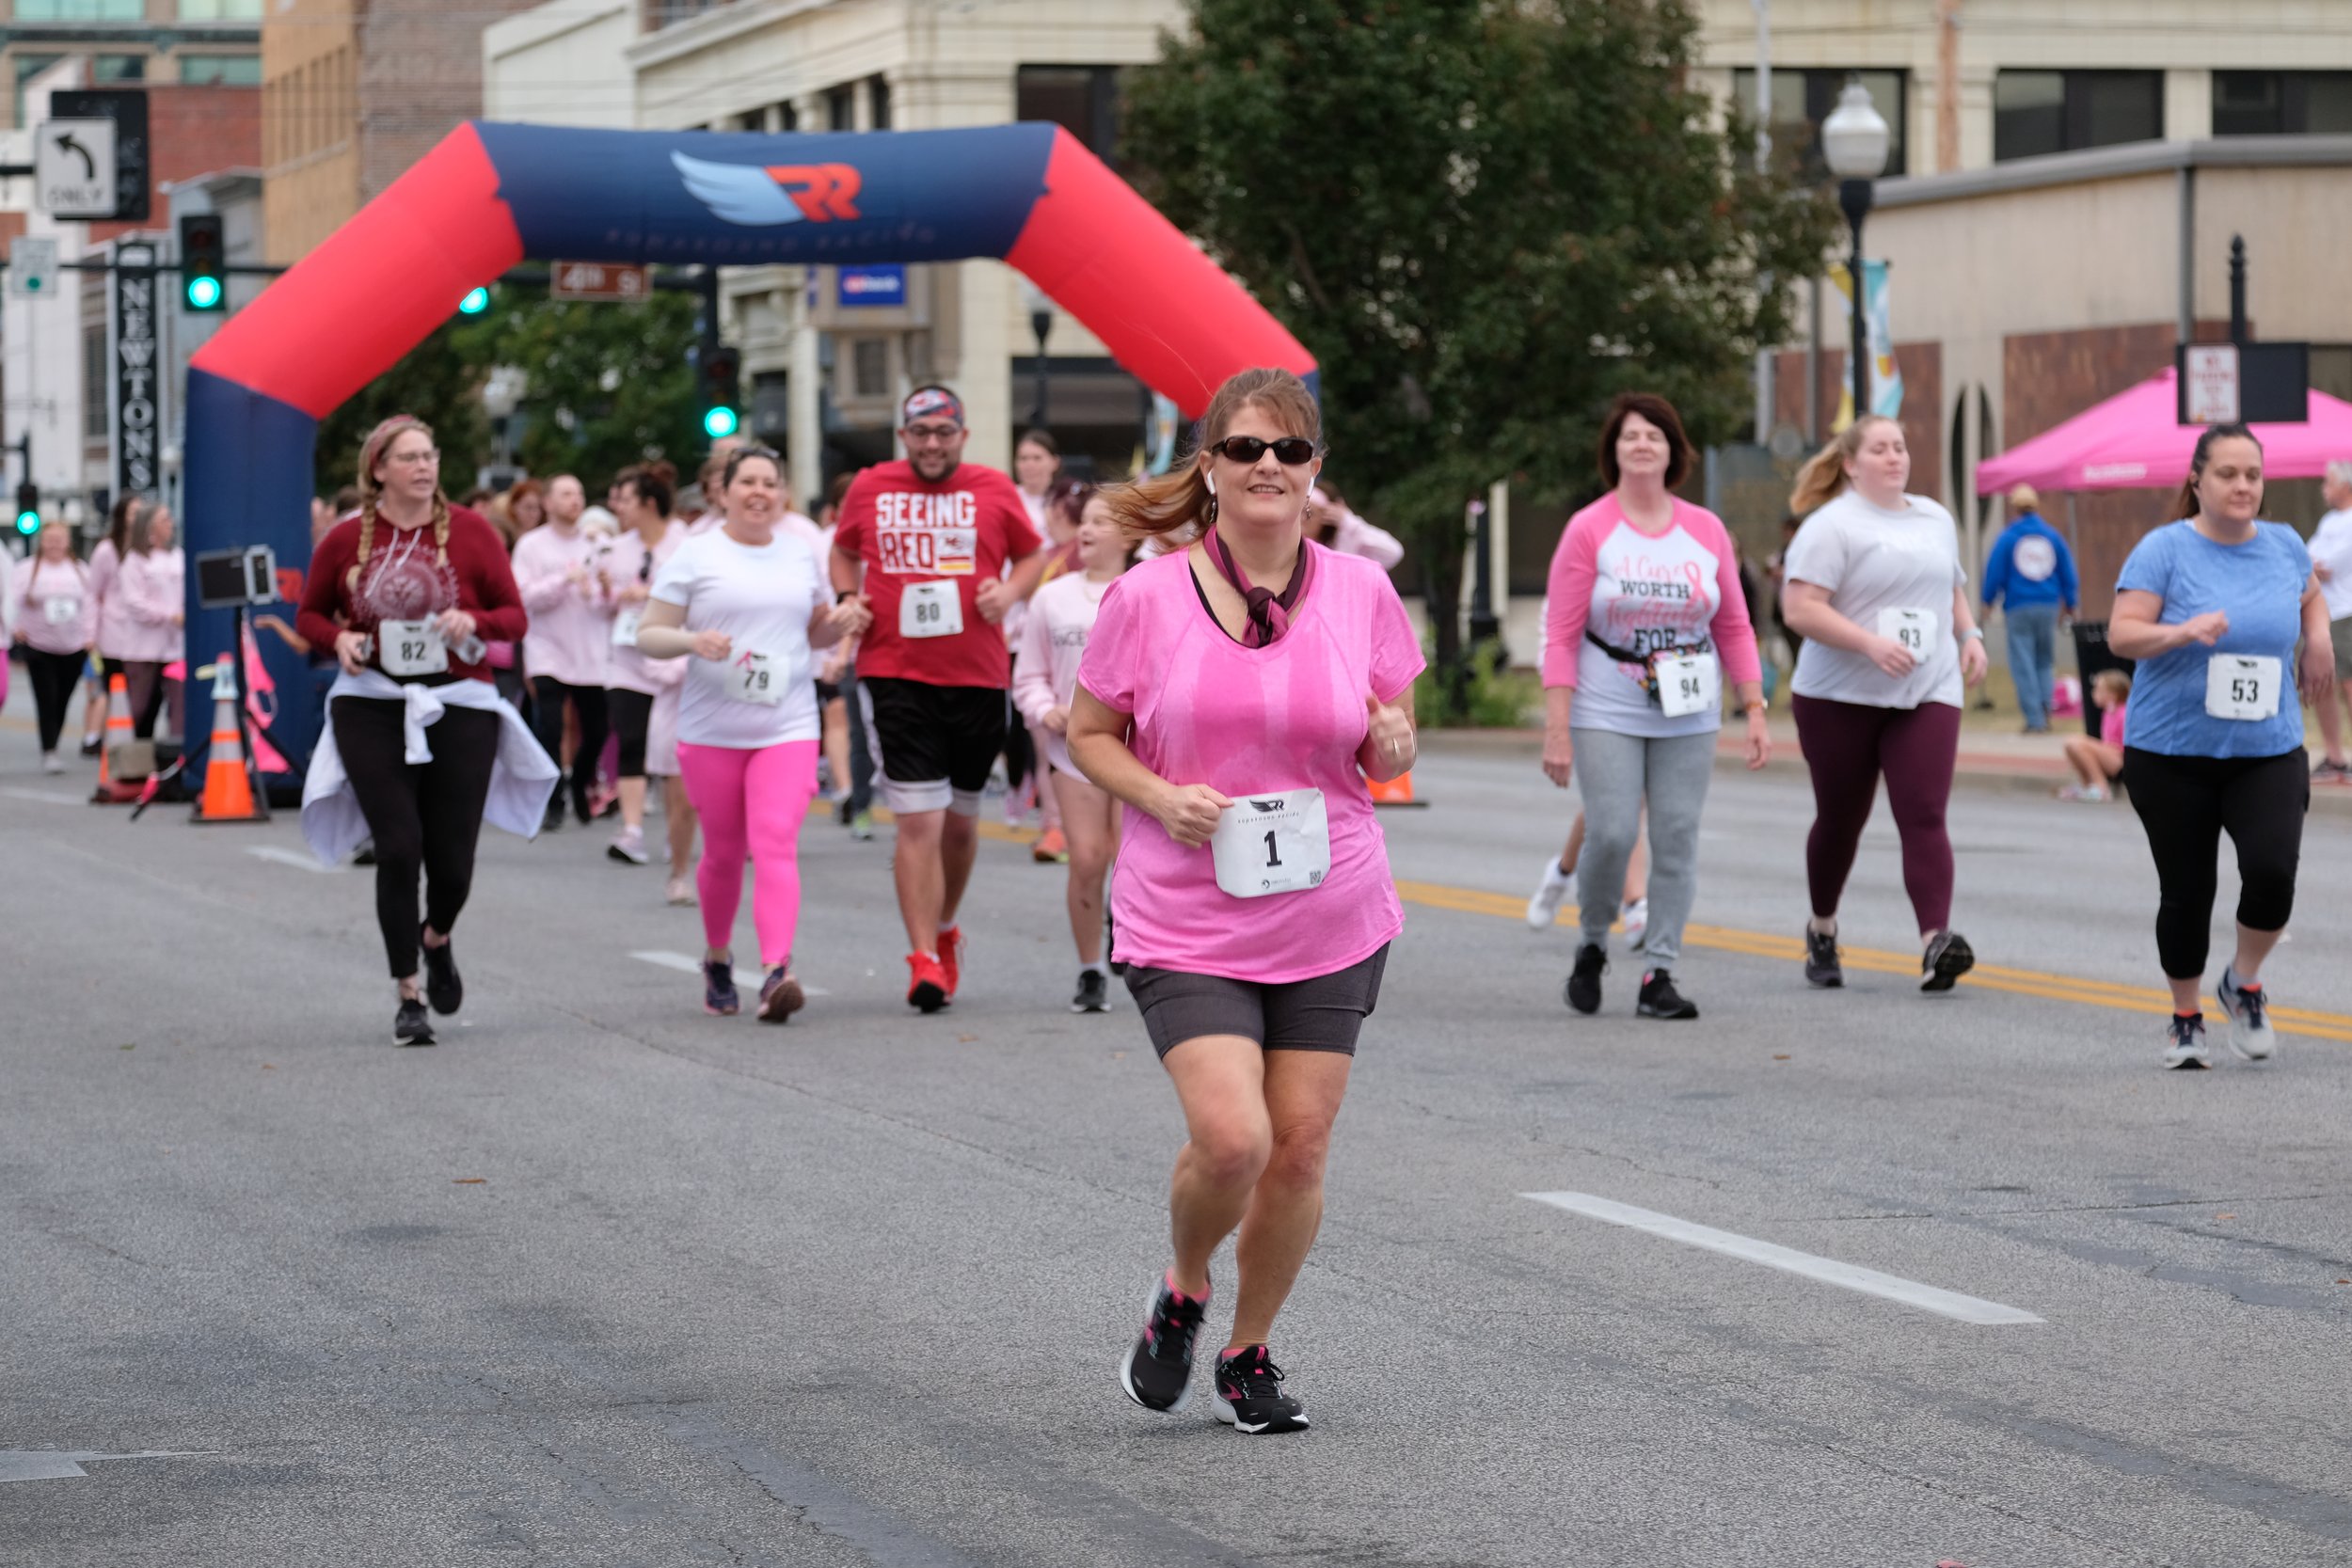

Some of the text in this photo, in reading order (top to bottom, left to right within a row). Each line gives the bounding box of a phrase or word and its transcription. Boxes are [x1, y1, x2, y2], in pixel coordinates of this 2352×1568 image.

[47, 187, 104, 205] ONLY
[119, 279, 155, 490] NEWTONS
[875, 490, 977, 528] SEEING
[882, 531, 934, 568] RED
[1620, 580, 1691, 599] WORTH
[915, 602, 940, 624] 80
[1634, 629, 1677, 651] FOR
[1899, 628, 1921, 648] 93
[402, 641, 426, 661] 82
[745, 671, 770, 690] 79
[1681, 678, 1700, 699] 94
[2232, 679, 2258, 704] 53
[1263, 830, 1282, 867] 1
